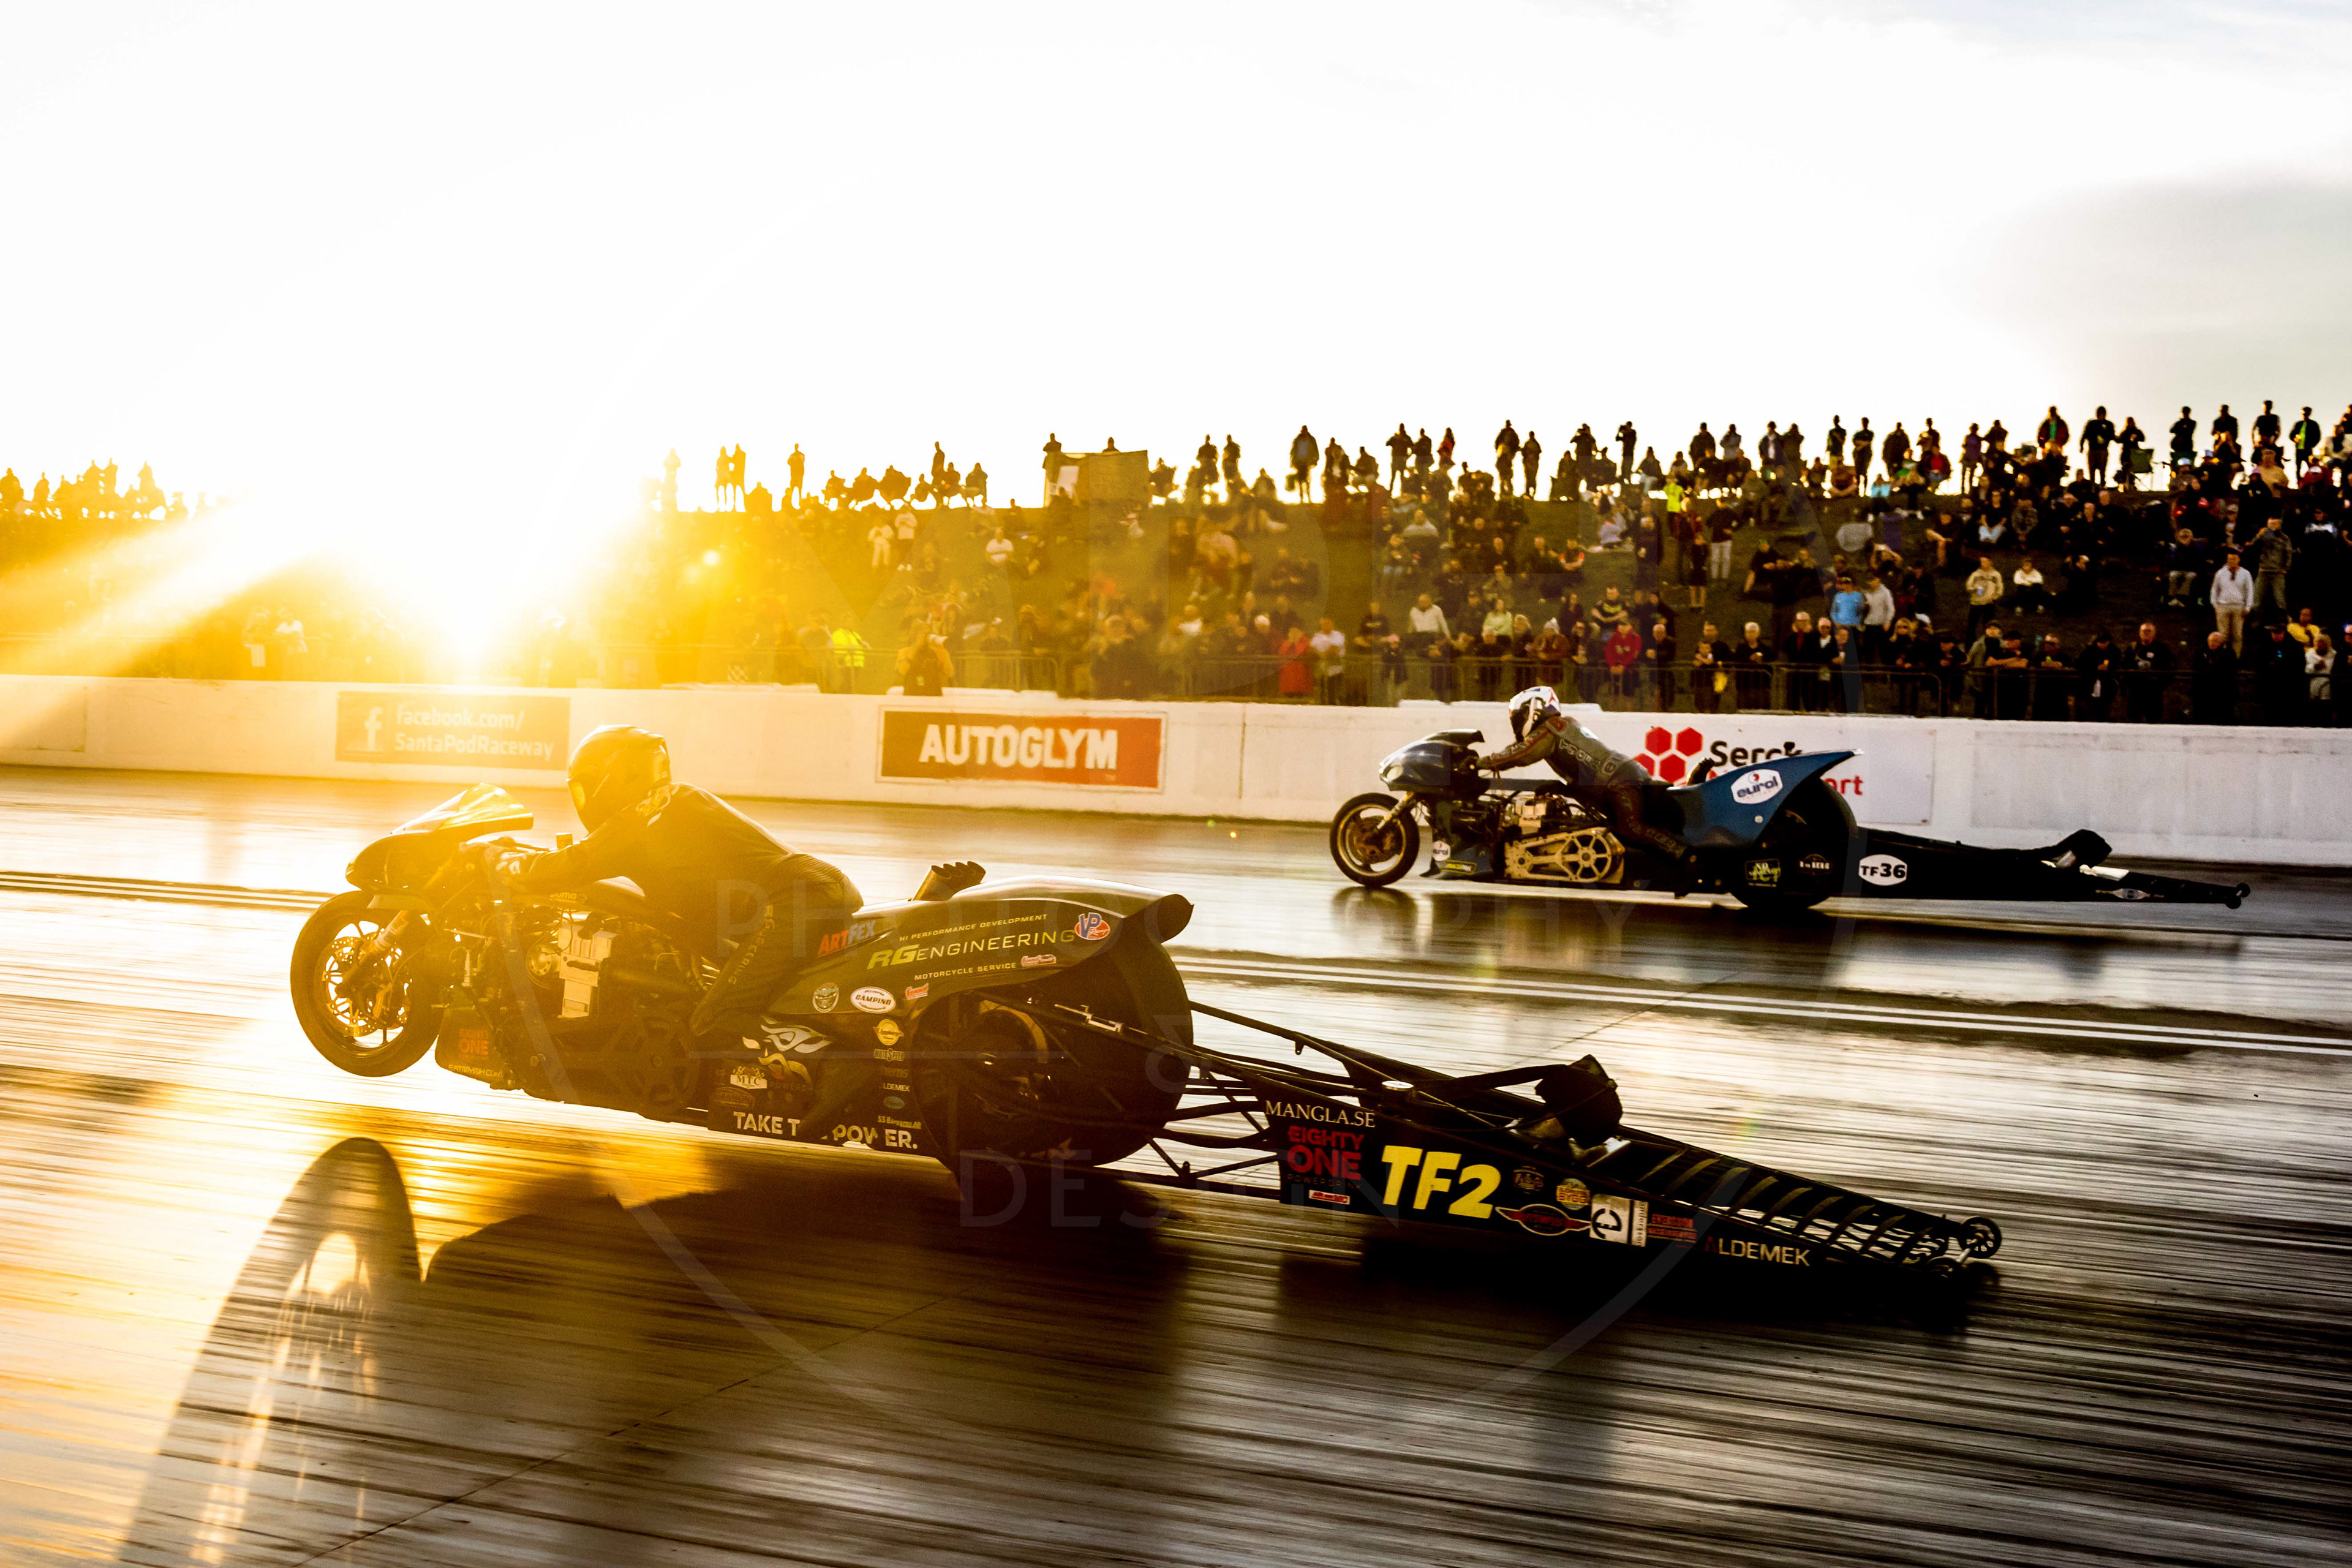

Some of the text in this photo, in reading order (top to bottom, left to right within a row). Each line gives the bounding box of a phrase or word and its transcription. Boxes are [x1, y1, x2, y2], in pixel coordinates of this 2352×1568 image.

[397, 703, 525, 729] facebook.com/
[394, 733, 554, 761] SantaPodRaceway
[919, 724, 1118, 769] AUTOGLYM
[1736, 777, 1779, 797] eurol
[1860, 863, 1906, 879] TF36
[911, 924, 976, 940] PERFORMANCE
[980, 914, 1048, 928] DEVELOPMENT
[1078, 912, 1102, 938] VP
[817, 920, 875, 957] ARTFEX
[914, 962, 1017, 980] MOTORCYCLE SERVICE
[459, 1038, 489, 1055] ONE
[733, 1111, 783, 1135] TAKE
[1265, 1100, 1376, 1128] MANGLA.SE
[1287, 1125, 1365, 1150] EIGHTY
[1287, 1144, 1362, 1181] ONE
[1381, 1145, 1501, 1219] TF2
